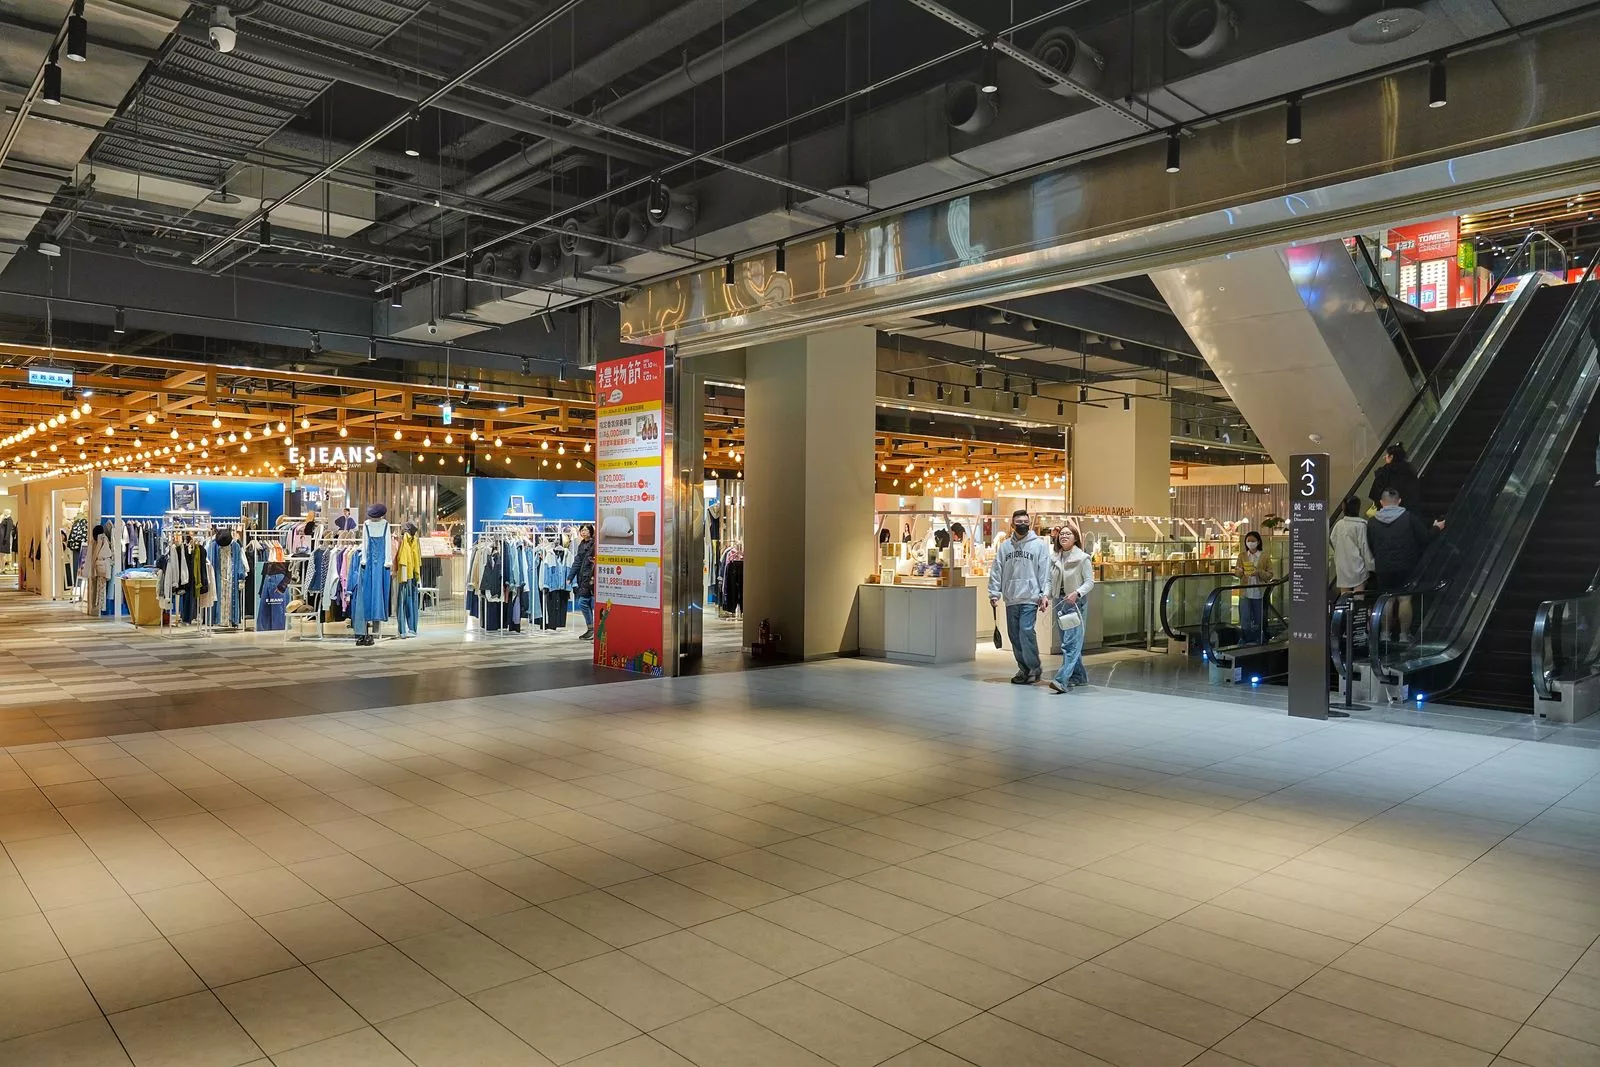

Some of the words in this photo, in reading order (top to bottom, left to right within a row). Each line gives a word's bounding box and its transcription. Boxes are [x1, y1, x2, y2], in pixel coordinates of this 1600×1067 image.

[1418, 231, 1450, 243] TOMICA
[598, 360, 641, 389] 禮物節
[289, 447, 299, 464] E
[308, 446, 376, 464] JEANS
[1301, 473, 1315, 497] 3
